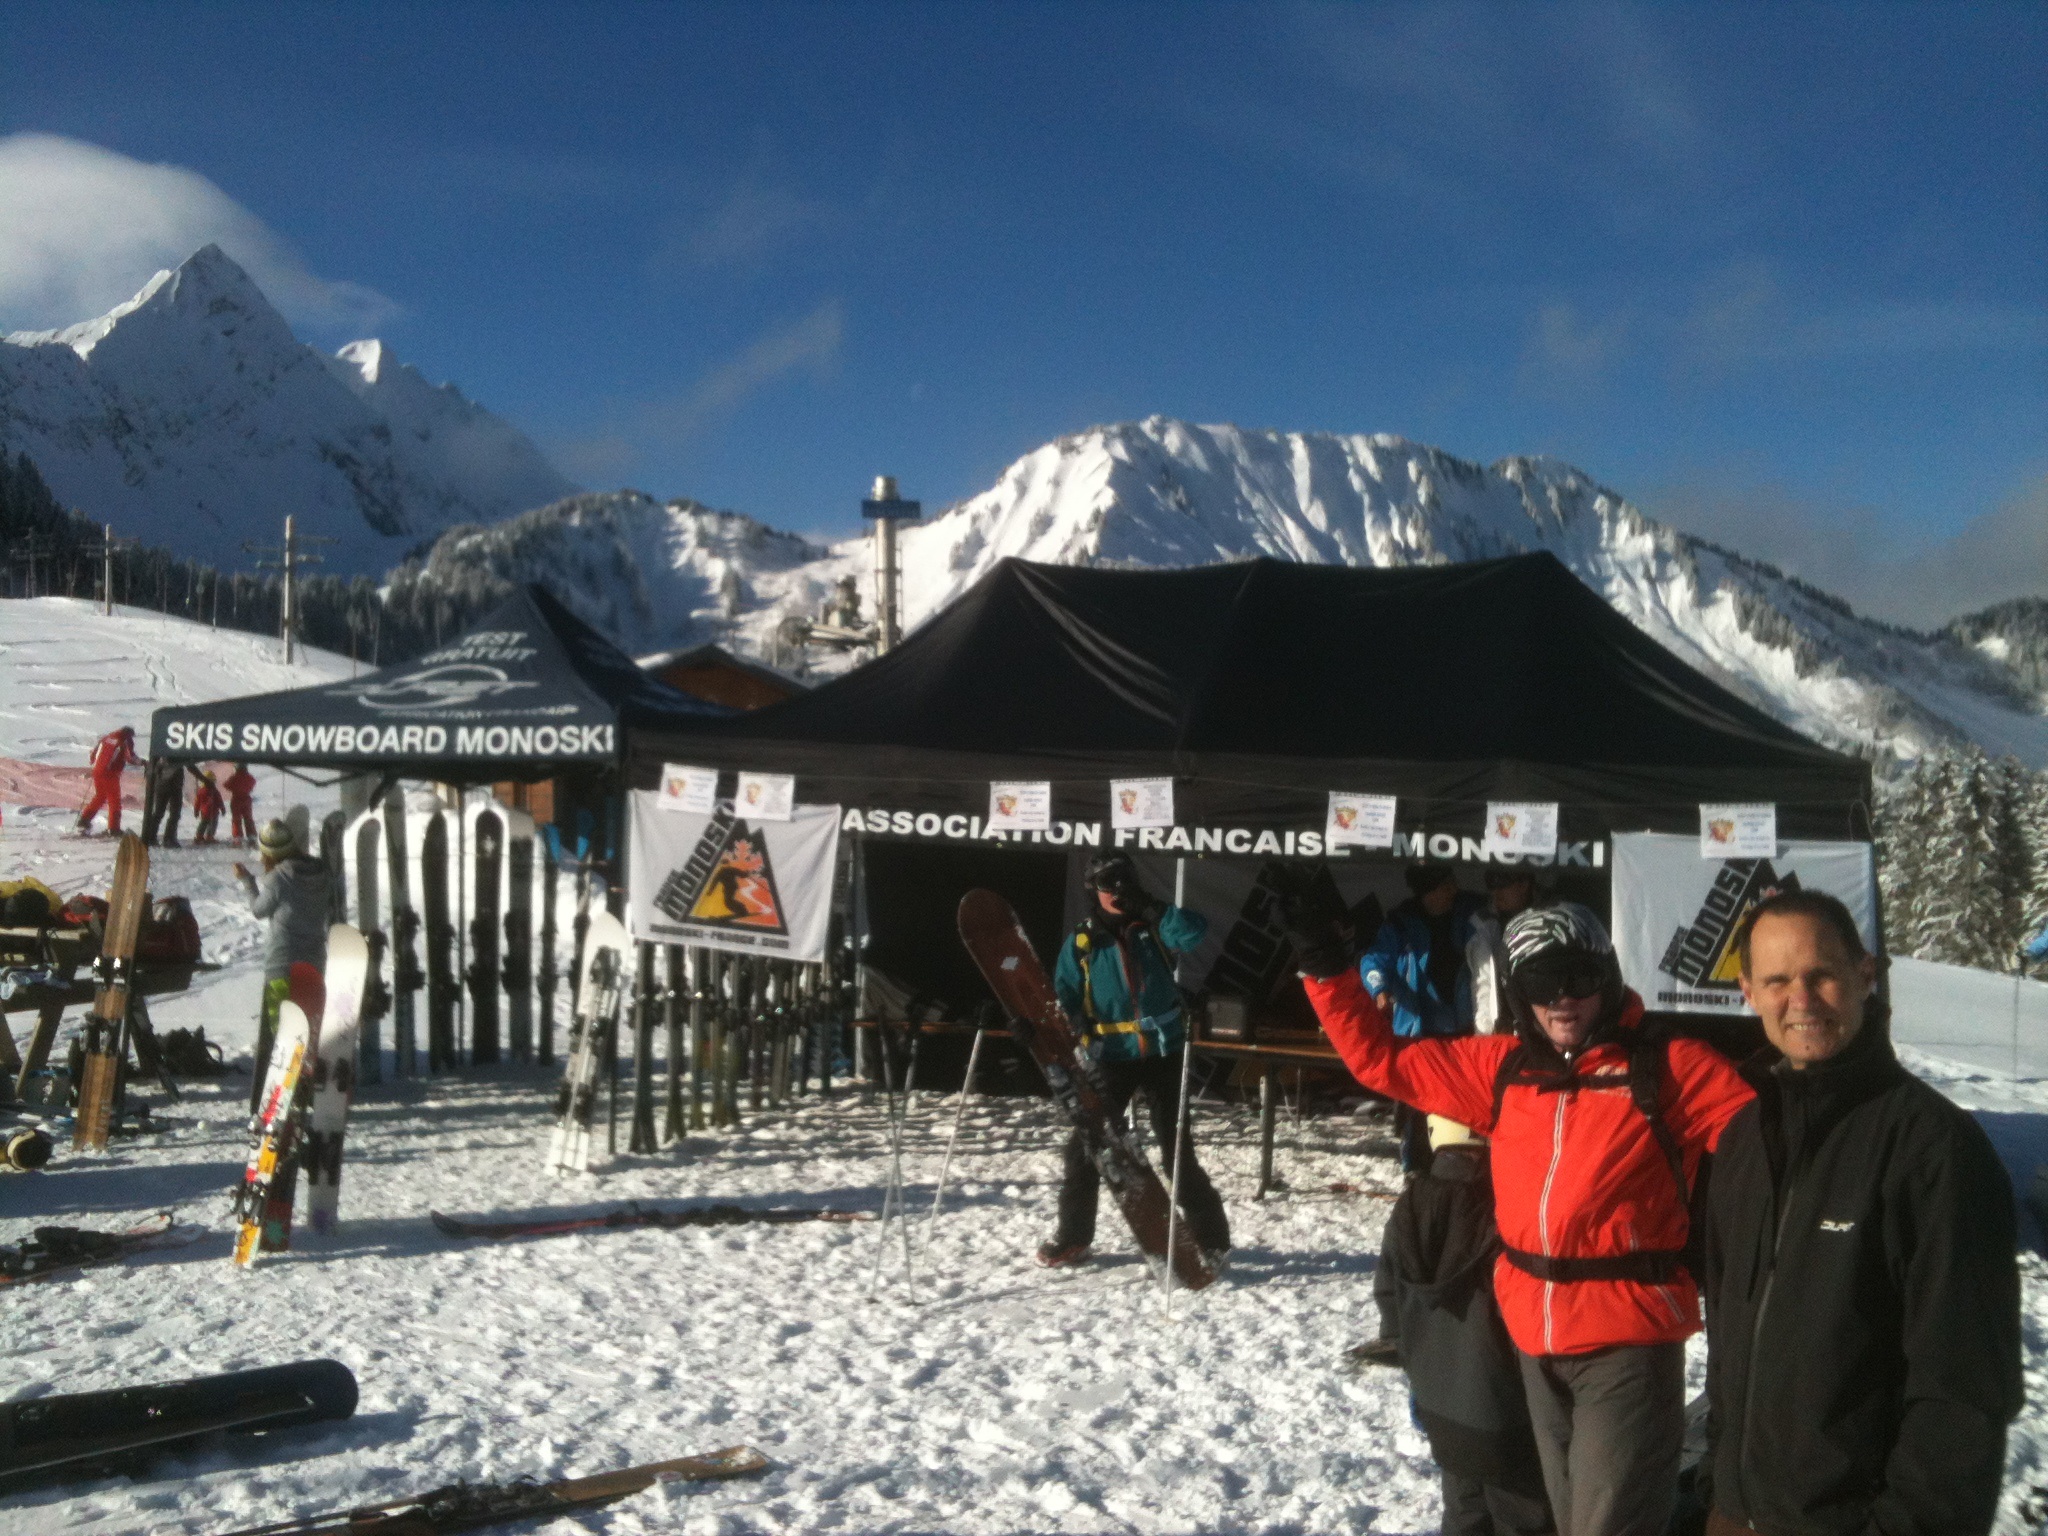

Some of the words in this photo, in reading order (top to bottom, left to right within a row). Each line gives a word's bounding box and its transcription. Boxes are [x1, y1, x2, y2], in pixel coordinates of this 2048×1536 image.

[166, 722, 233, 750] SKIS
[241, 723, 447, 753] SNOWBOARD
[456, 724, 615, 755] MONOSKI
